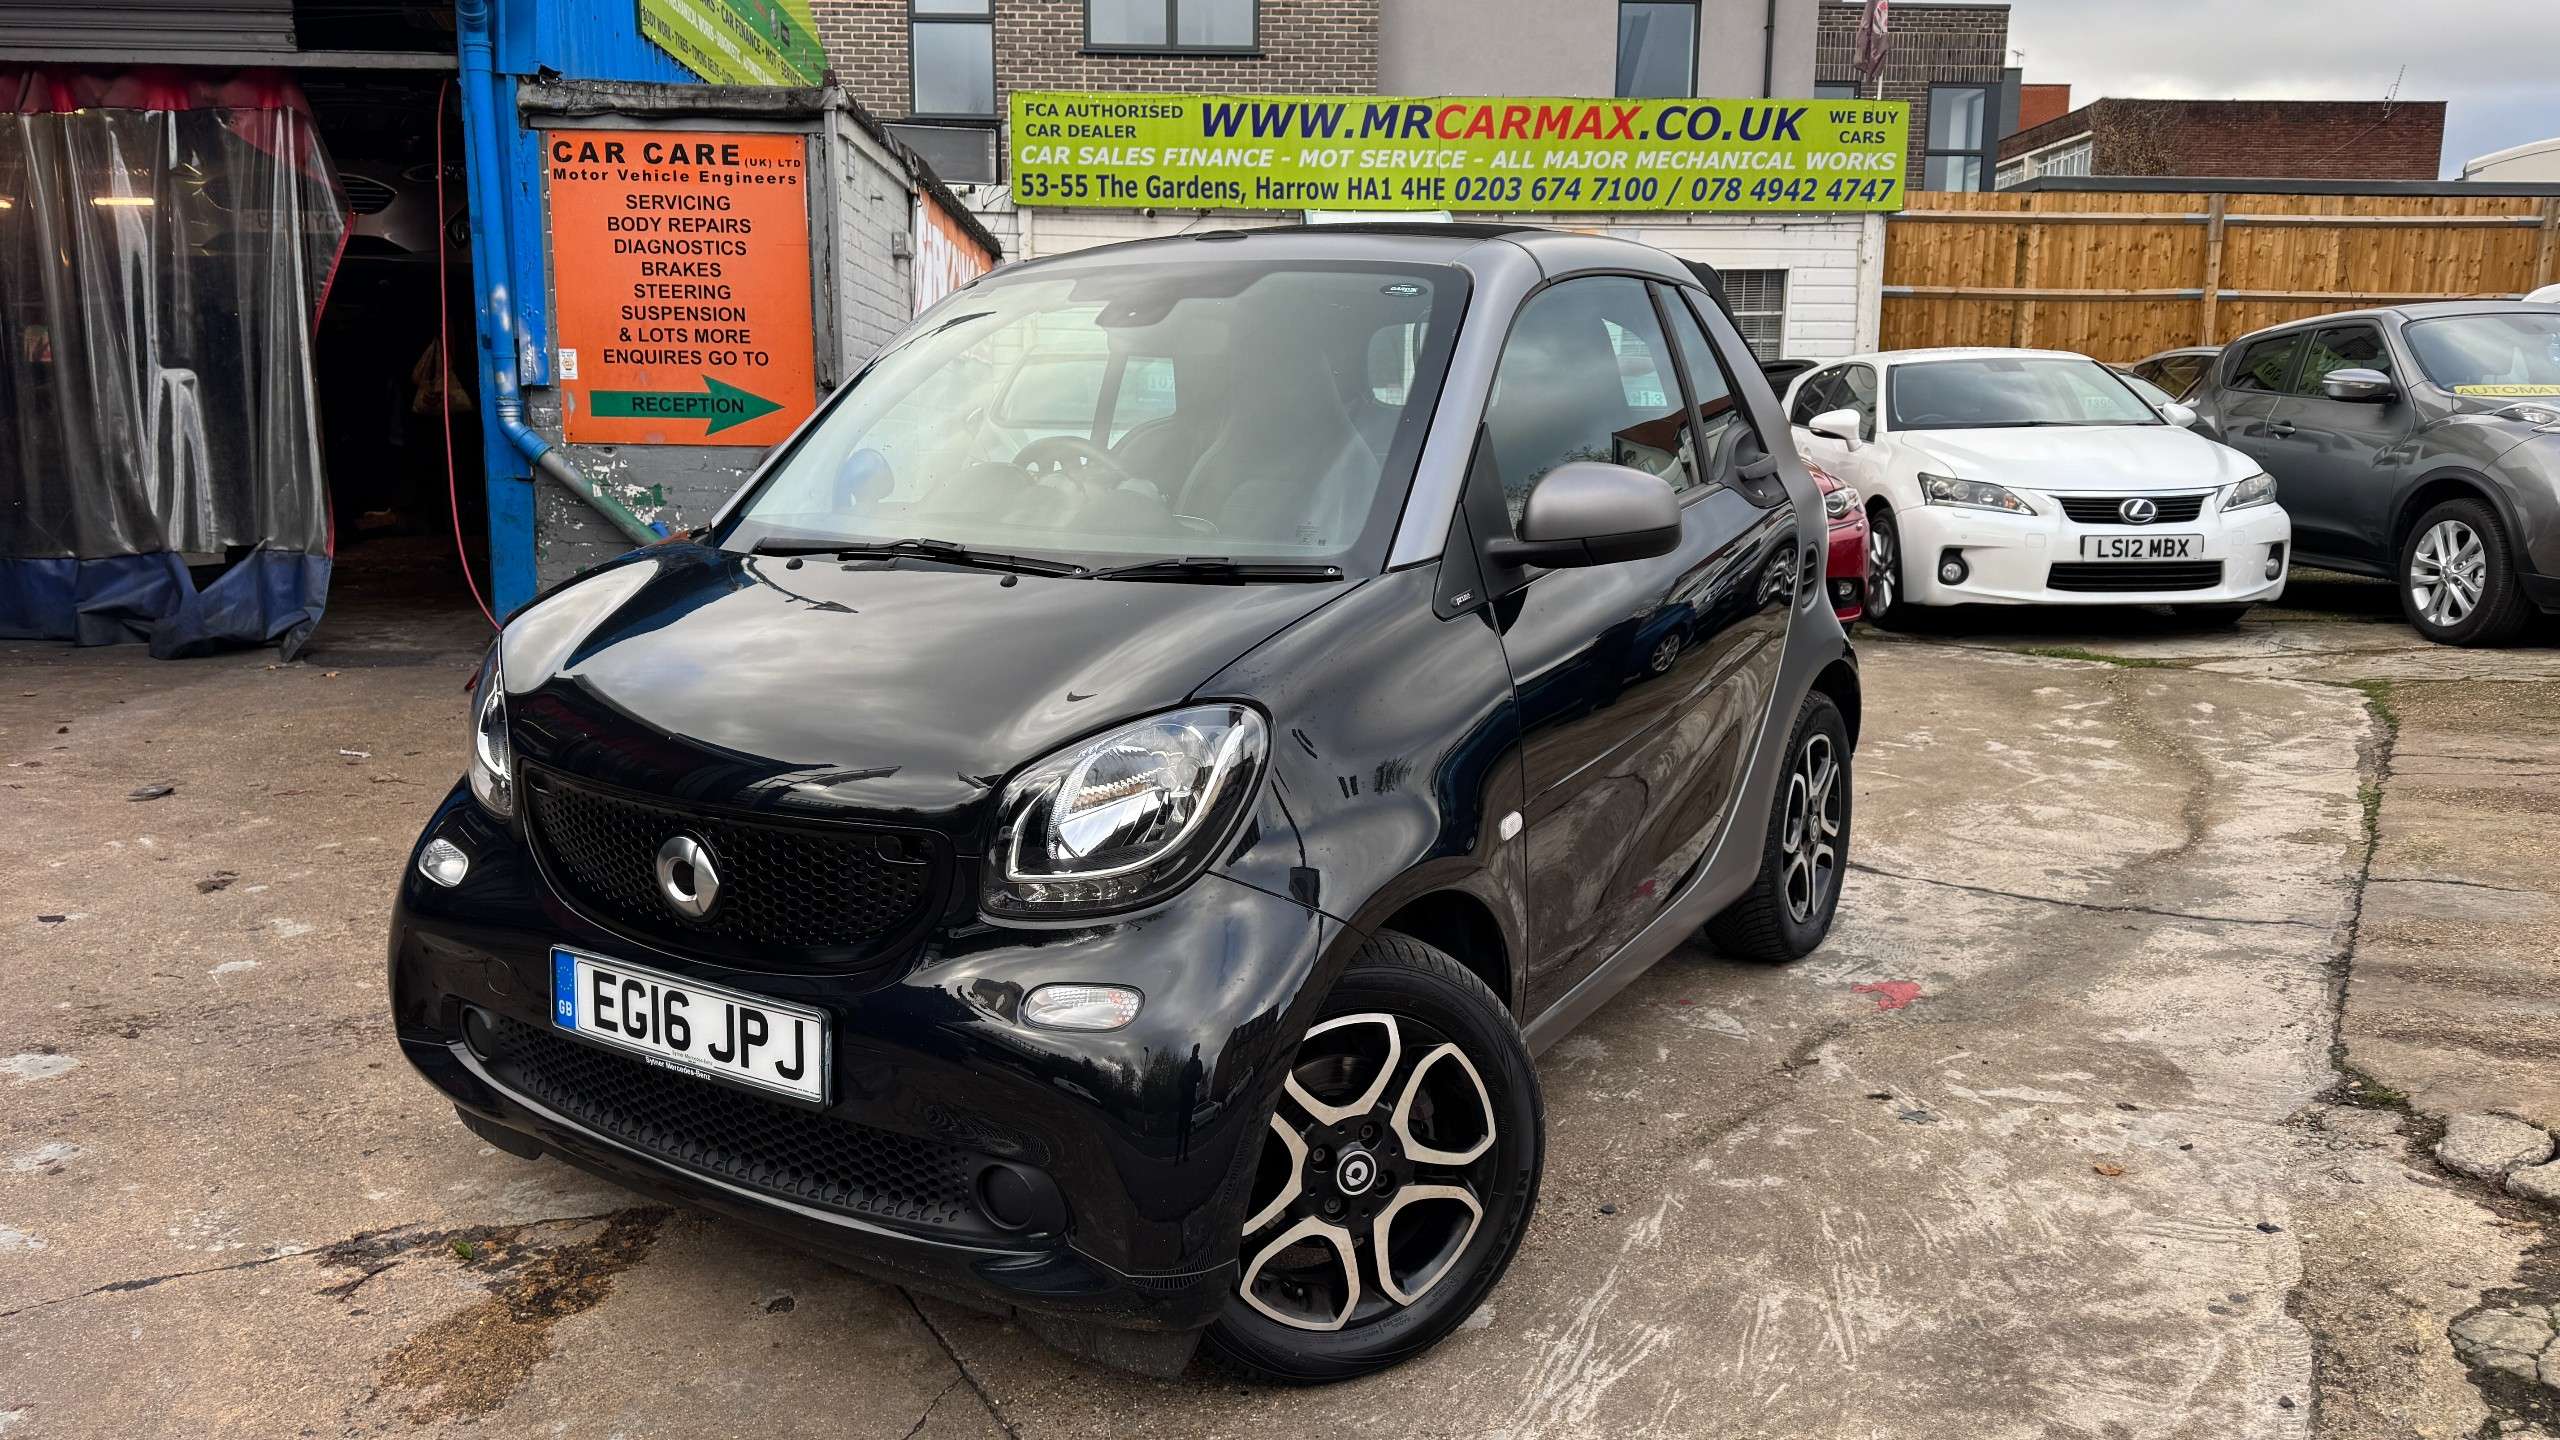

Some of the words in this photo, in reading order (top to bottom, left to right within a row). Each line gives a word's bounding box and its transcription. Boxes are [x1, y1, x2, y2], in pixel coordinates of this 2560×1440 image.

[1025, 103, 1059, 118] FCA
[1065, 104, 1183, 119] AUTHORISED
[1829, 111, 1858, 124] WE
[1863, 111, 1898, 125] BUY
[1025, 123, 1061, 138] CAR
[1068, 124, 1136, 139] DEALER
[1201, 103, 1808, 141] WWW.MRCARMAX.CO.UK
[1838, 130, 1886, 144] CARS
[552, 141, 626, 164] CAR
[642, 143, 740, 166] CARE
[744, 157, 773, 169] (UK)
[778, 158, 801, 168] LTD
[1020, 145, 1070, 166] CAR
[1077, 146, 1155, 167] SALES
[1162, 147, 1273, 168] FINANCE
[1298, 149, 1354, 168] MOT
[1359, 149, 1466, 169] SERVICE
[1490, 150, 1534, 169] ALL
[1544, 150, 1628, 170] MAJOR
[1635, 151, 1795, 171] MECHANICAL
[1805, 152, 1897, 171] WORKS
[552, 168, 610, 182] Motor
[617, 169, 689, 183] Vehicle
[699, 170, 797, 187] Engineers
[1020, 173, 1088, 198] 53-55
[1096, 174, 1138, 199] The
[1144, 174, 1246, 205] Gardens,
[1255, 176, 1338, 200] Harrow
[1347, 177, 1391, 201] HA1
[1401, 177, 1445, 201] 4HE
[1454, 176, 1522, 201] 0203
[1531, 177, 1582, 201] 674
[1592, 177, 1658, 201] 7100
[1691, 177, 1742, 202] 078
[1750, 178, 1818, 202] 4942
[1826, 178, 1896, 203] 4747
[625, 194, 731, 211] SERVICING
[607, 217, 662, 233] BODY
[668, 217, 752, 234] REPAIRS
[613, 239, 747, 257] DIAGNOSTICS
[641, 261, 722, 279] BRAKES
[633, 283, 732, 301] STEERING
[621, 305, 746, 323] SUSPENSION
[619, 328, 632, 344] &
[638, 328, 688, 344] LOTS
[694, 328, 751, 345] MORE
[603, 349, 702, 367] ENQUIRES
[708, 350, 738, 367] GO
[743, 350, 769, 367] TO
[632, 396, 744, 414] RECEPTION
[2097, 538, 2143, 559] LS12
[2149, 538, 2190, 558] MBX
[558, 999, 573, 1017] GB
[592, 969, 692, 1051] EG16
[708, 1003, 805, 1081] JPJ
